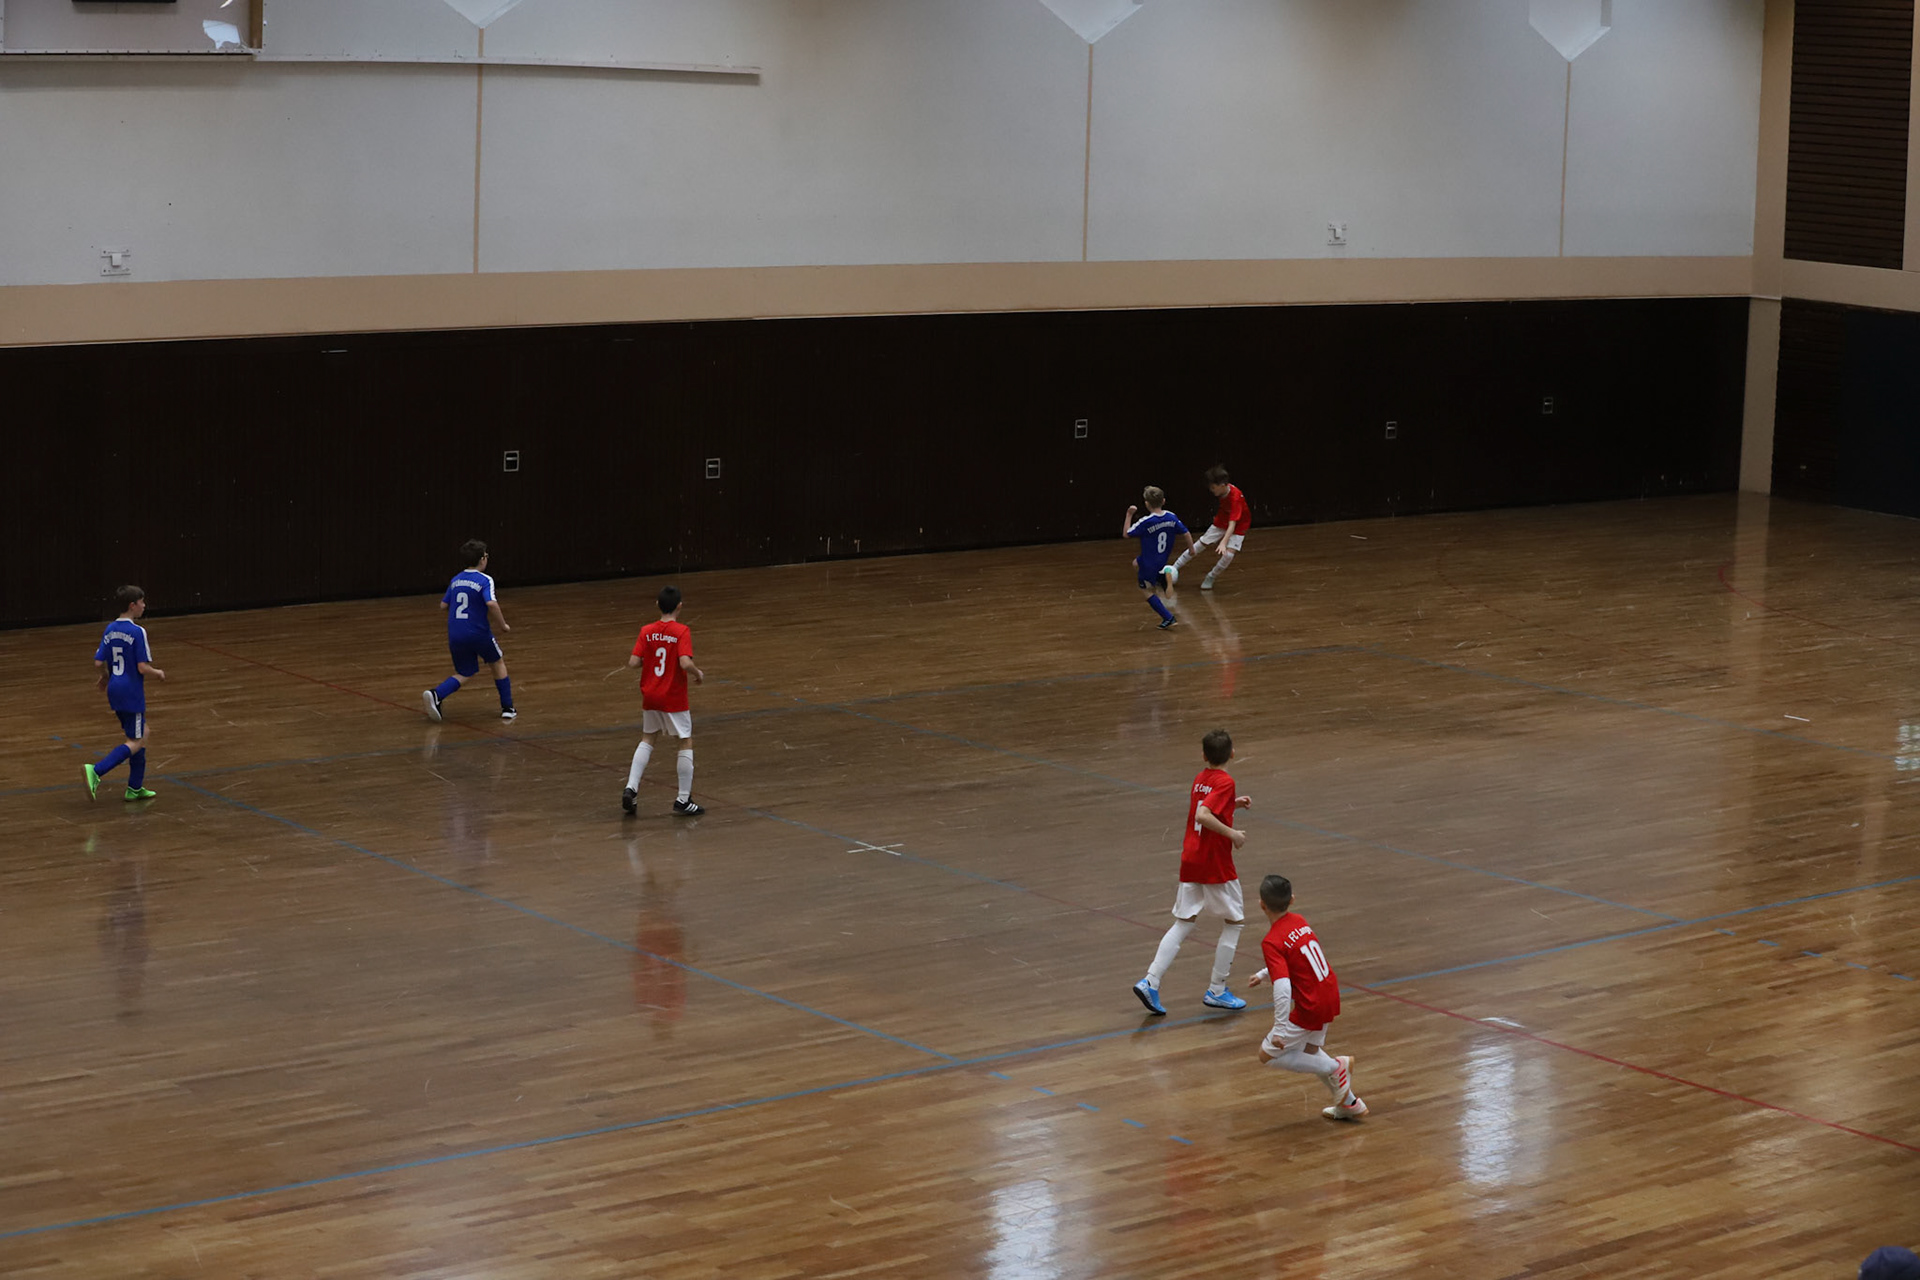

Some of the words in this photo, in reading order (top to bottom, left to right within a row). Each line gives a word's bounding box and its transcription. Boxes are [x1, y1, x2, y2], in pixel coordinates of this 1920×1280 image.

[1157, 531, 1168, 554] 8
[456, 592, 469, 619] 2
[651, 633, 660, 641] FC
[112, 646, 125, 676] 5
[654, 646, 667, 677] 3
[1288, 931, 1299, 943] FC
[1300, 940, 1330, 982] 10
